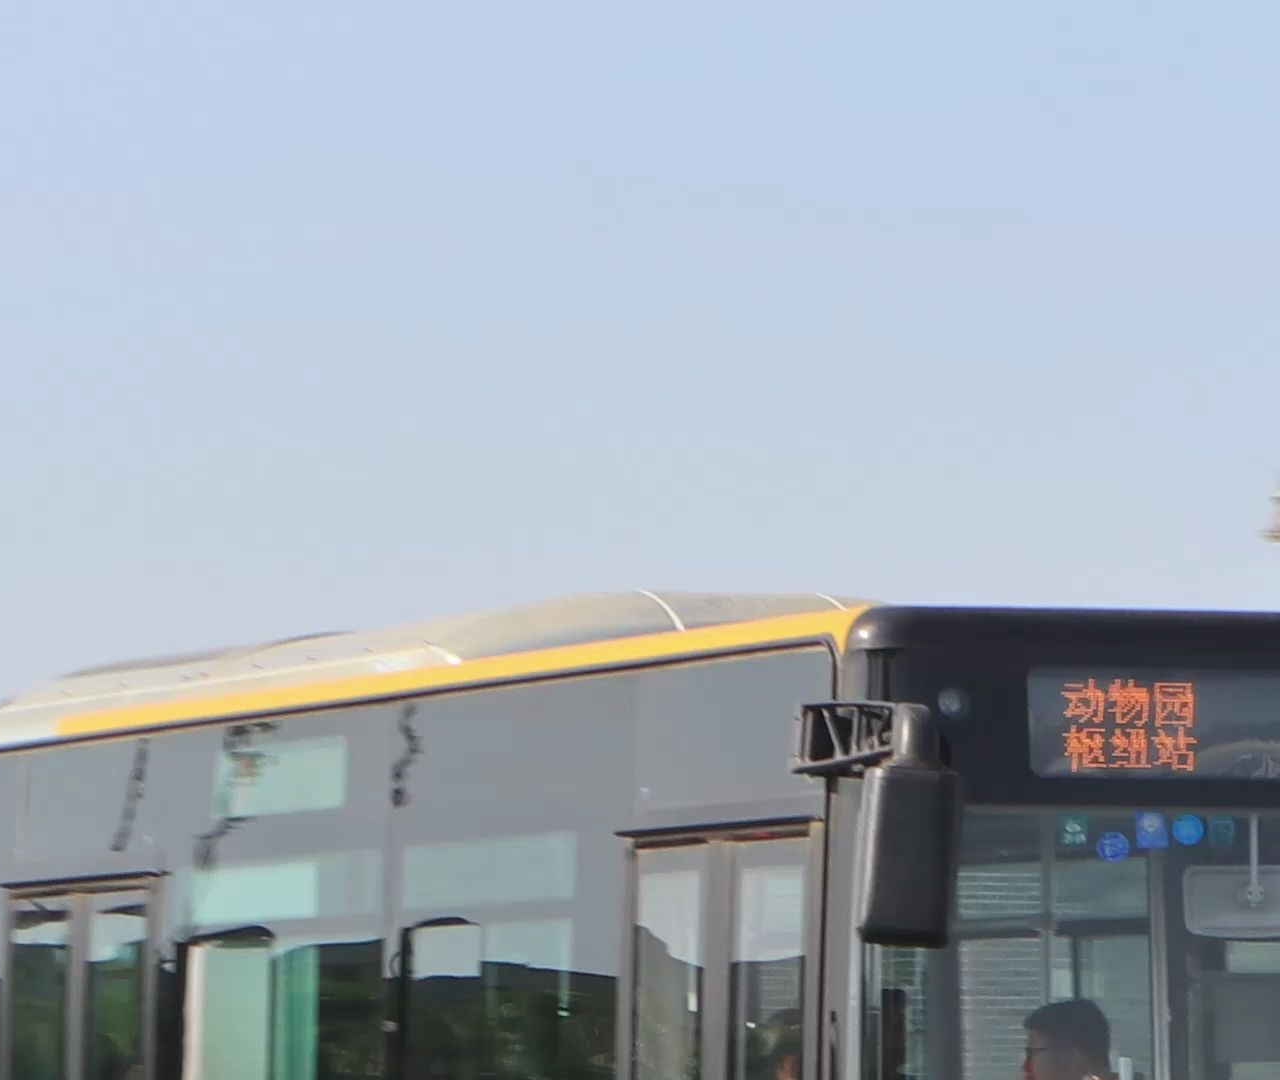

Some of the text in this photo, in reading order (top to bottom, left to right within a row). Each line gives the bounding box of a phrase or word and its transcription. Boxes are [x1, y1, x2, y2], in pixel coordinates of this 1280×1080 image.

[1060, 678, 1195, 727] 动物园
[1061, 725, 1198, 772] 枢纽站
